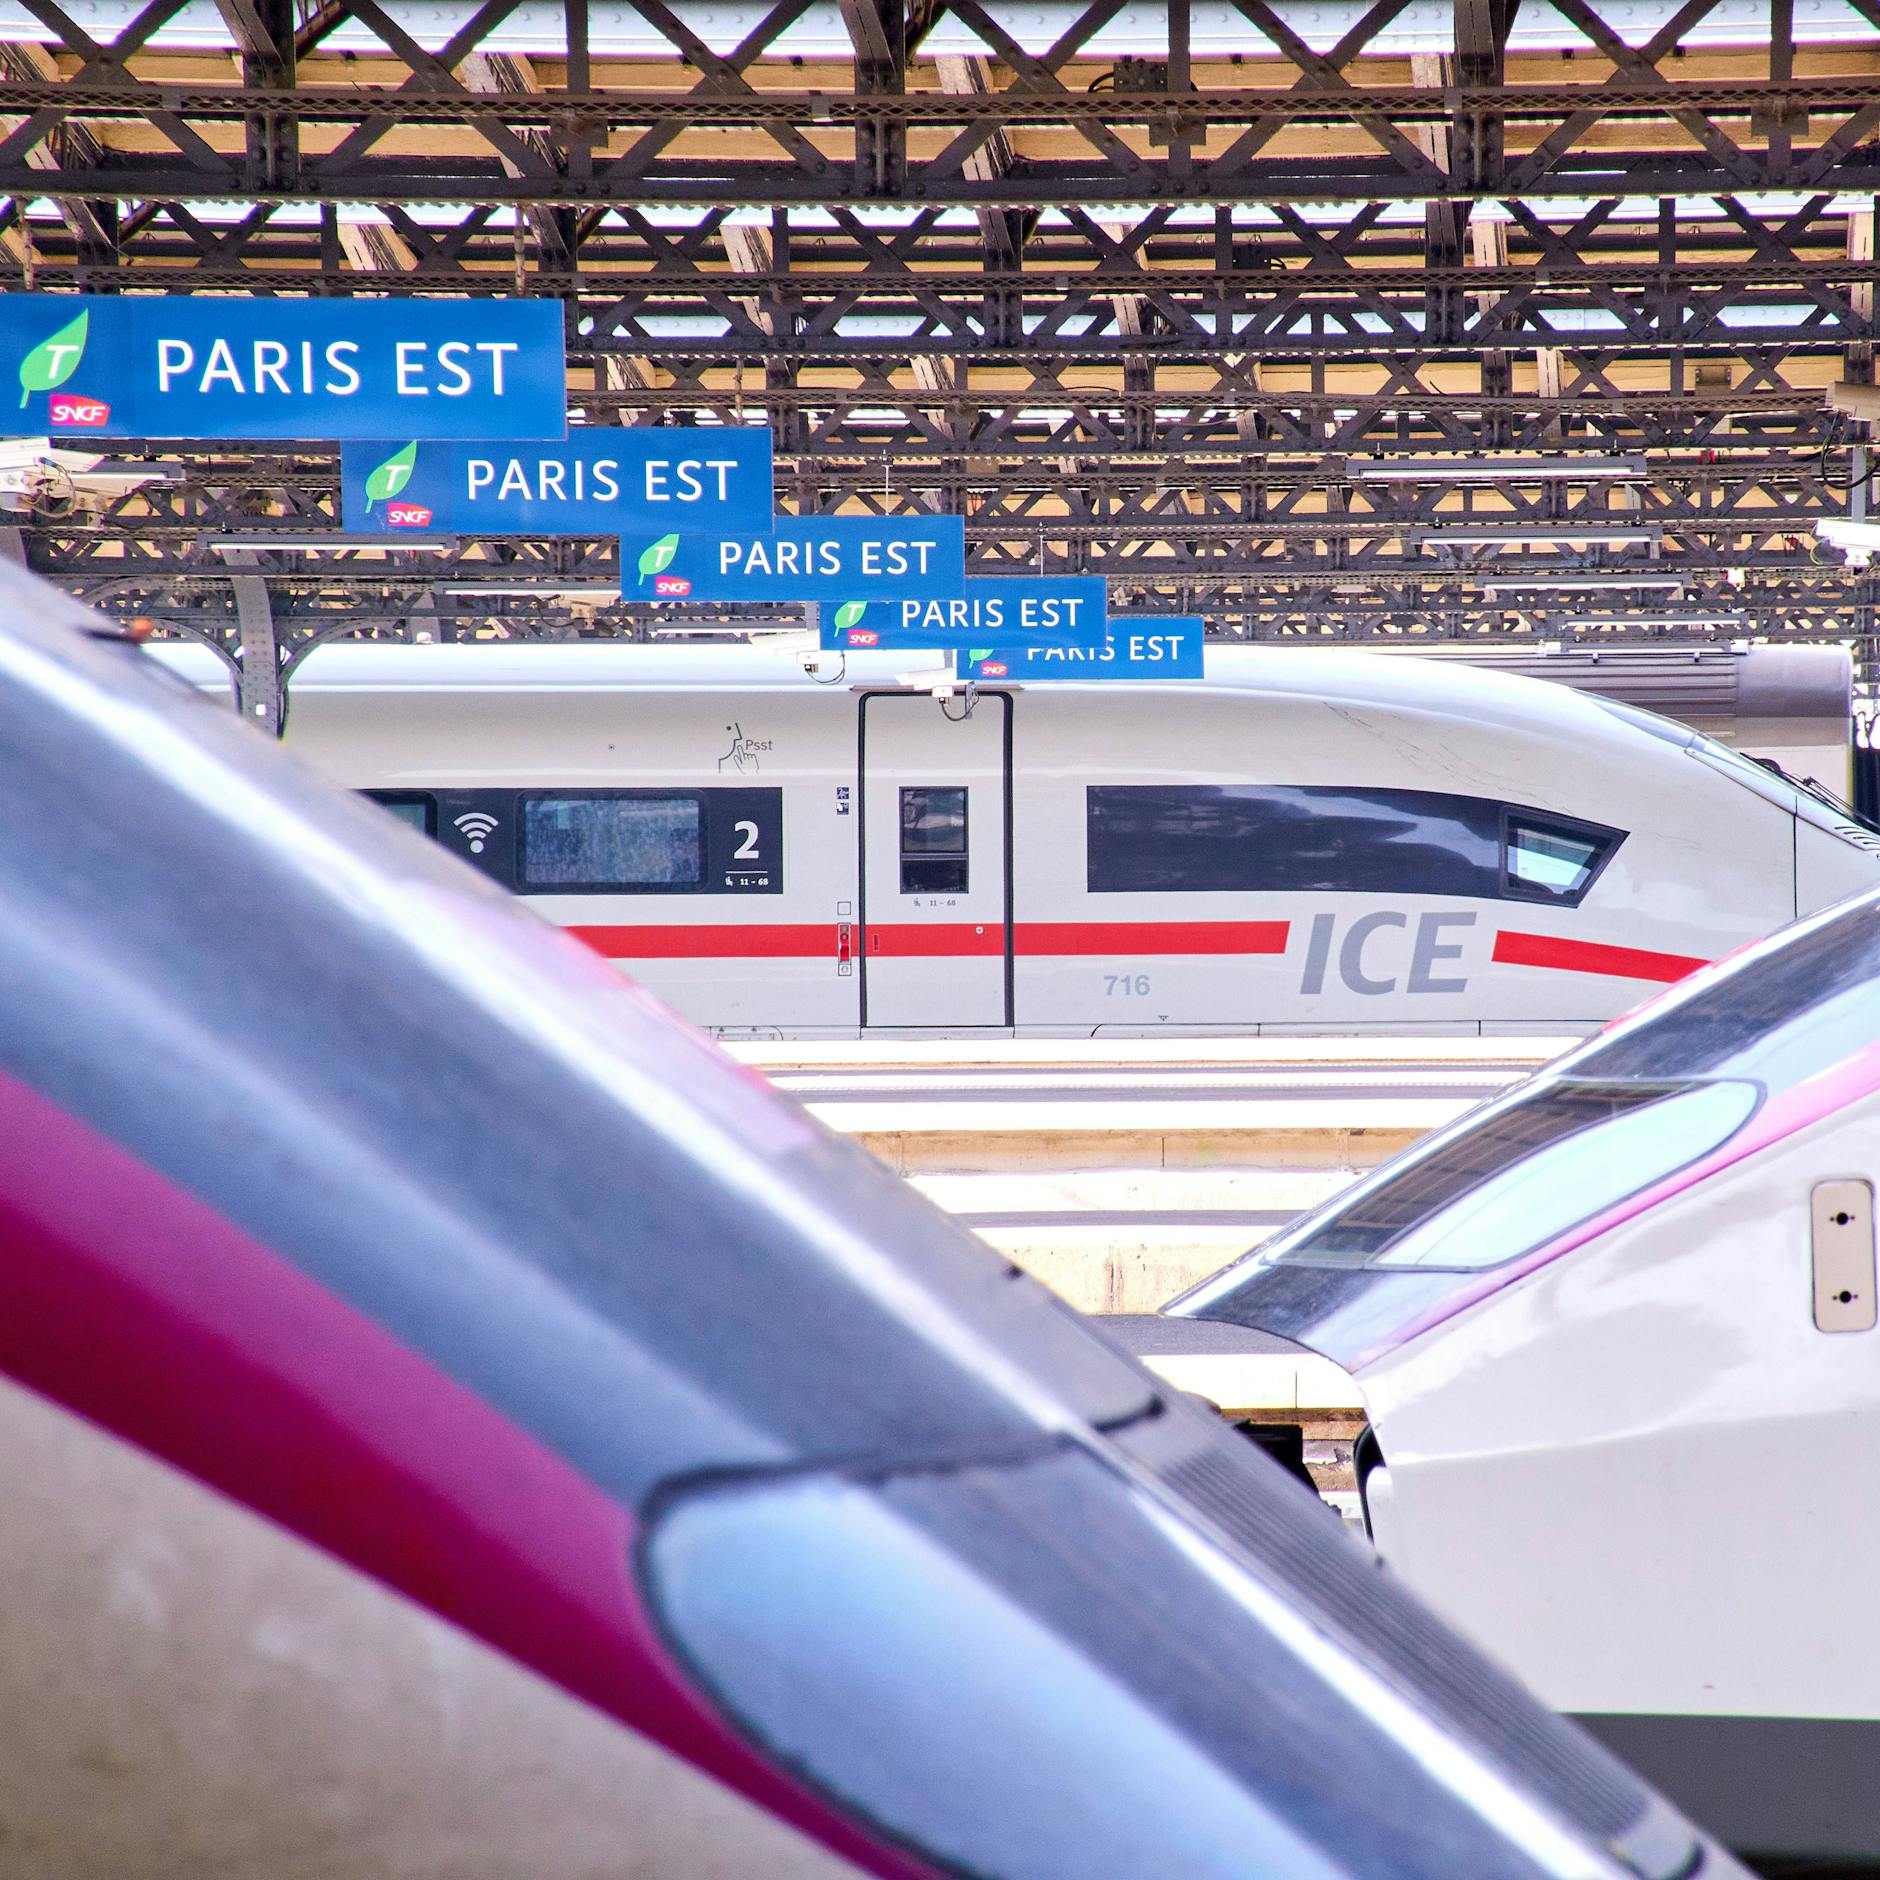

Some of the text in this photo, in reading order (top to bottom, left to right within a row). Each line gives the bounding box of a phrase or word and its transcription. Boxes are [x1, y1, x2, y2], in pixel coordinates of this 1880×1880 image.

[46, 344, 80, 380] T
[158, 338, 518, 396] PARIS EST
[52, 405, 106, 423] SNCF
[384, 464, 410, 492] T
[467, 459, 738, 502] PARIS EST
[389, 510, 429, 524] SNCF
[720, 541, 937, 575] PARIS EST
[656, 582, 689, 593] SNCF
[902, 598, 1084, 628] PARIS EST
[850, 634, 877, 645] SNCF
[1130, 636, 1185, 661] EST
[981, 665, 1007, 675] SNCF
[745, 740, 773, 751] Psst
[733, 820, 760, 859] 2
[740, 878, 749, 886] 11
[758, 878, 769, 886] 68
[930, 899, 937, 907] 11
[1300, 911, 1477, 996] ICE
[1103, 974, 1151, 997] 716
